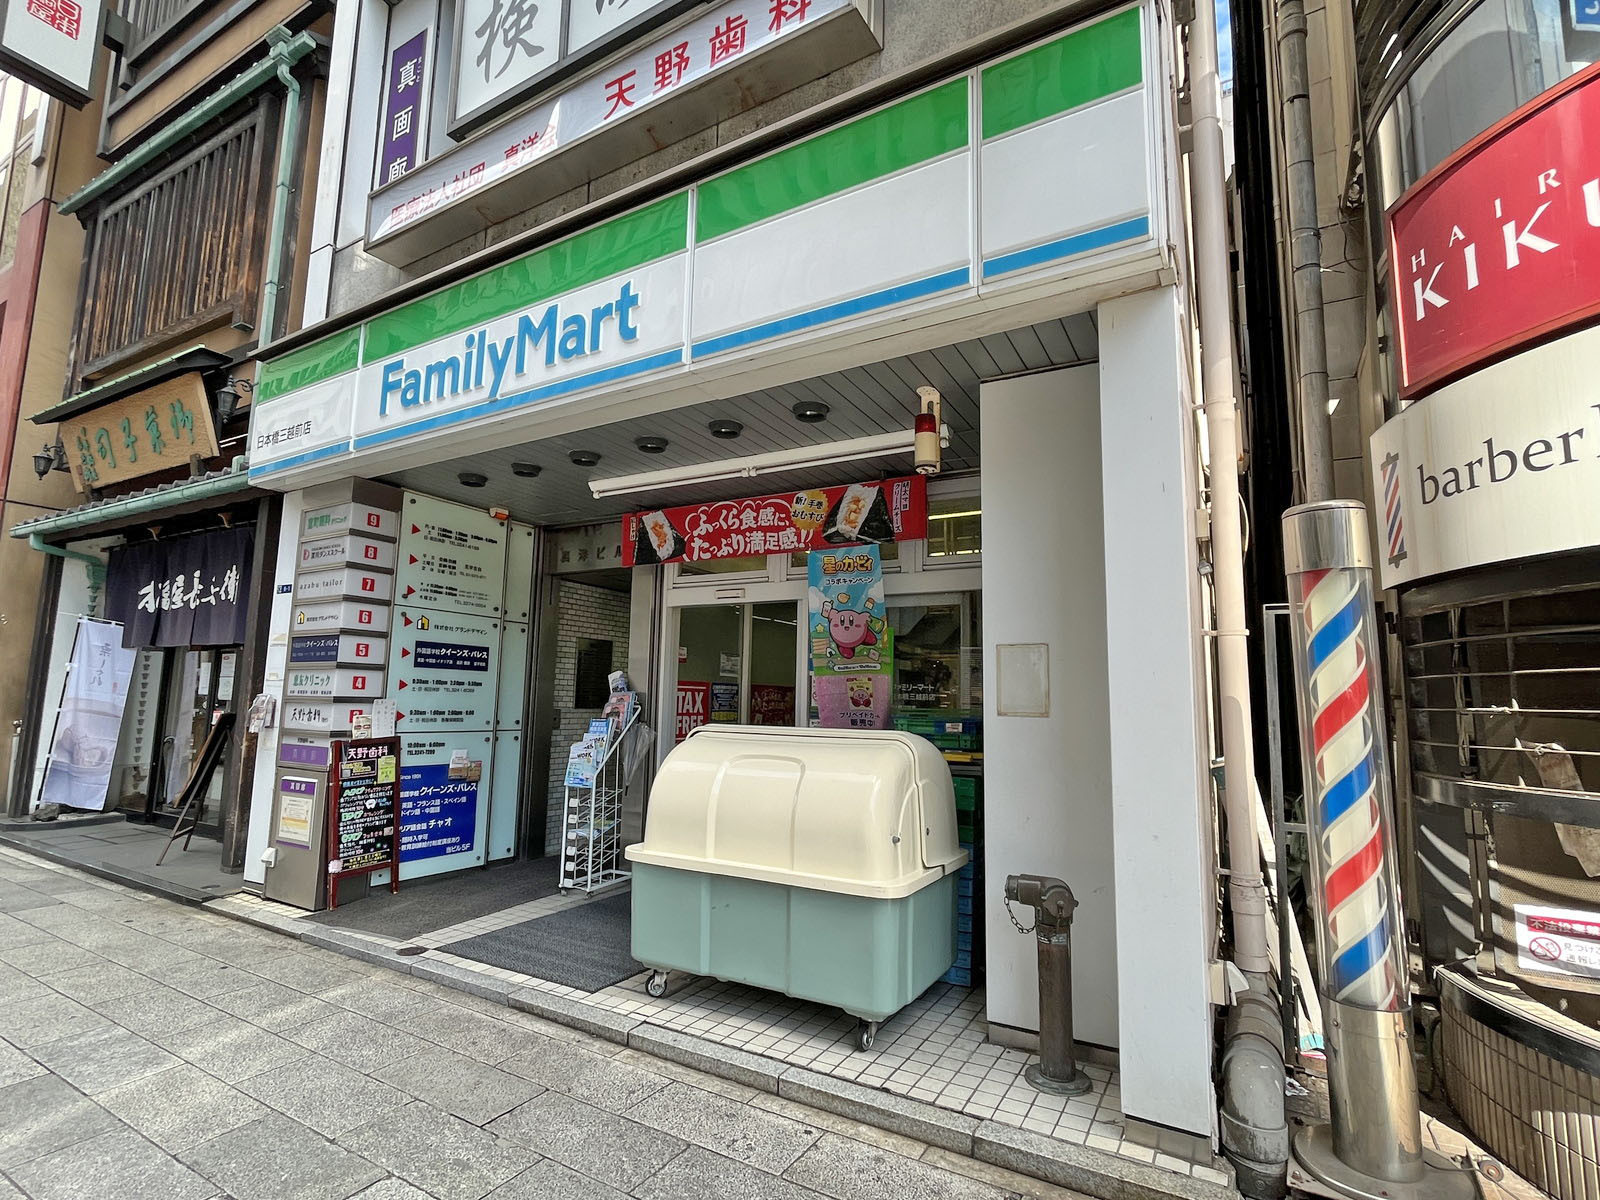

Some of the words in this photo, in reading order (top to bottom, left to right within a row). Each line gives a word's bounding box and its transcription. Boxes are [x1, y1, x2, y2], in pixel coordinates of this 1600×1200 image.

[603, 0, 812, 121] 天野歯科
[388, 58, 418, 184] 真画廊
[390, 161, 486, 227] 医療法人社団
[1411, 167, 1562, 274] HAIR
[378, 280, 642, 418] FamilyMart
[256, 420, 312, 449] 日本橋三越前店
[1416, 428, 1584, 506] barber
[791, 509, 825, 522] おむすび
[322, 577, 343, 587] tailor
[825, 577, 874, 586] コラボキャンペーン
[677, 691, 704, 714] TAX
[676, 715, 704, 735] FREE
[347, 745, 389, 760] 天野歯科
[428, 817, 453, 829] チャオ
